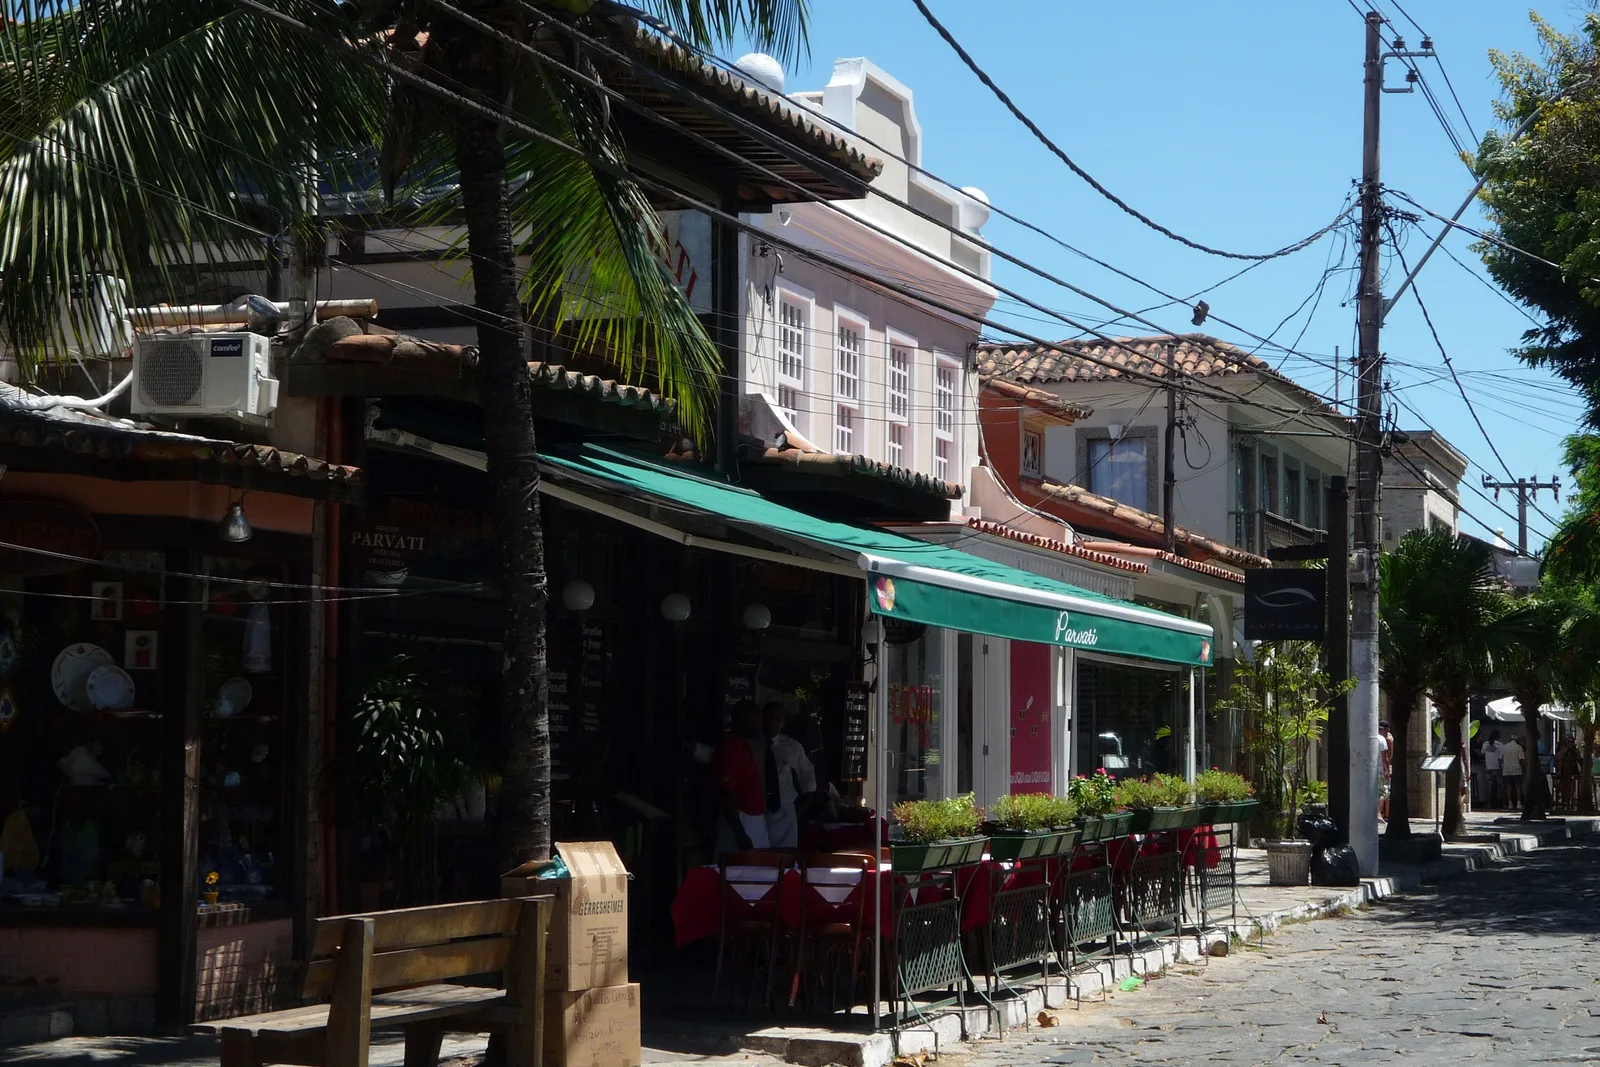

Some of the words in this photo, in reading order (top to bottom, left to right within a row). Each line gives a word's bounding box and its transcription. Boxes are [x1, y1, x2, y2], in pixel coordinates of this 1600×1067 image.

[350, 531, 425, 551] PARVATI
[368, 557, 406, 568] TRATTORIA
[1055, 610, 1098, 647] Parvati
[578, 895, 625, 916] GERRESHEIMER
